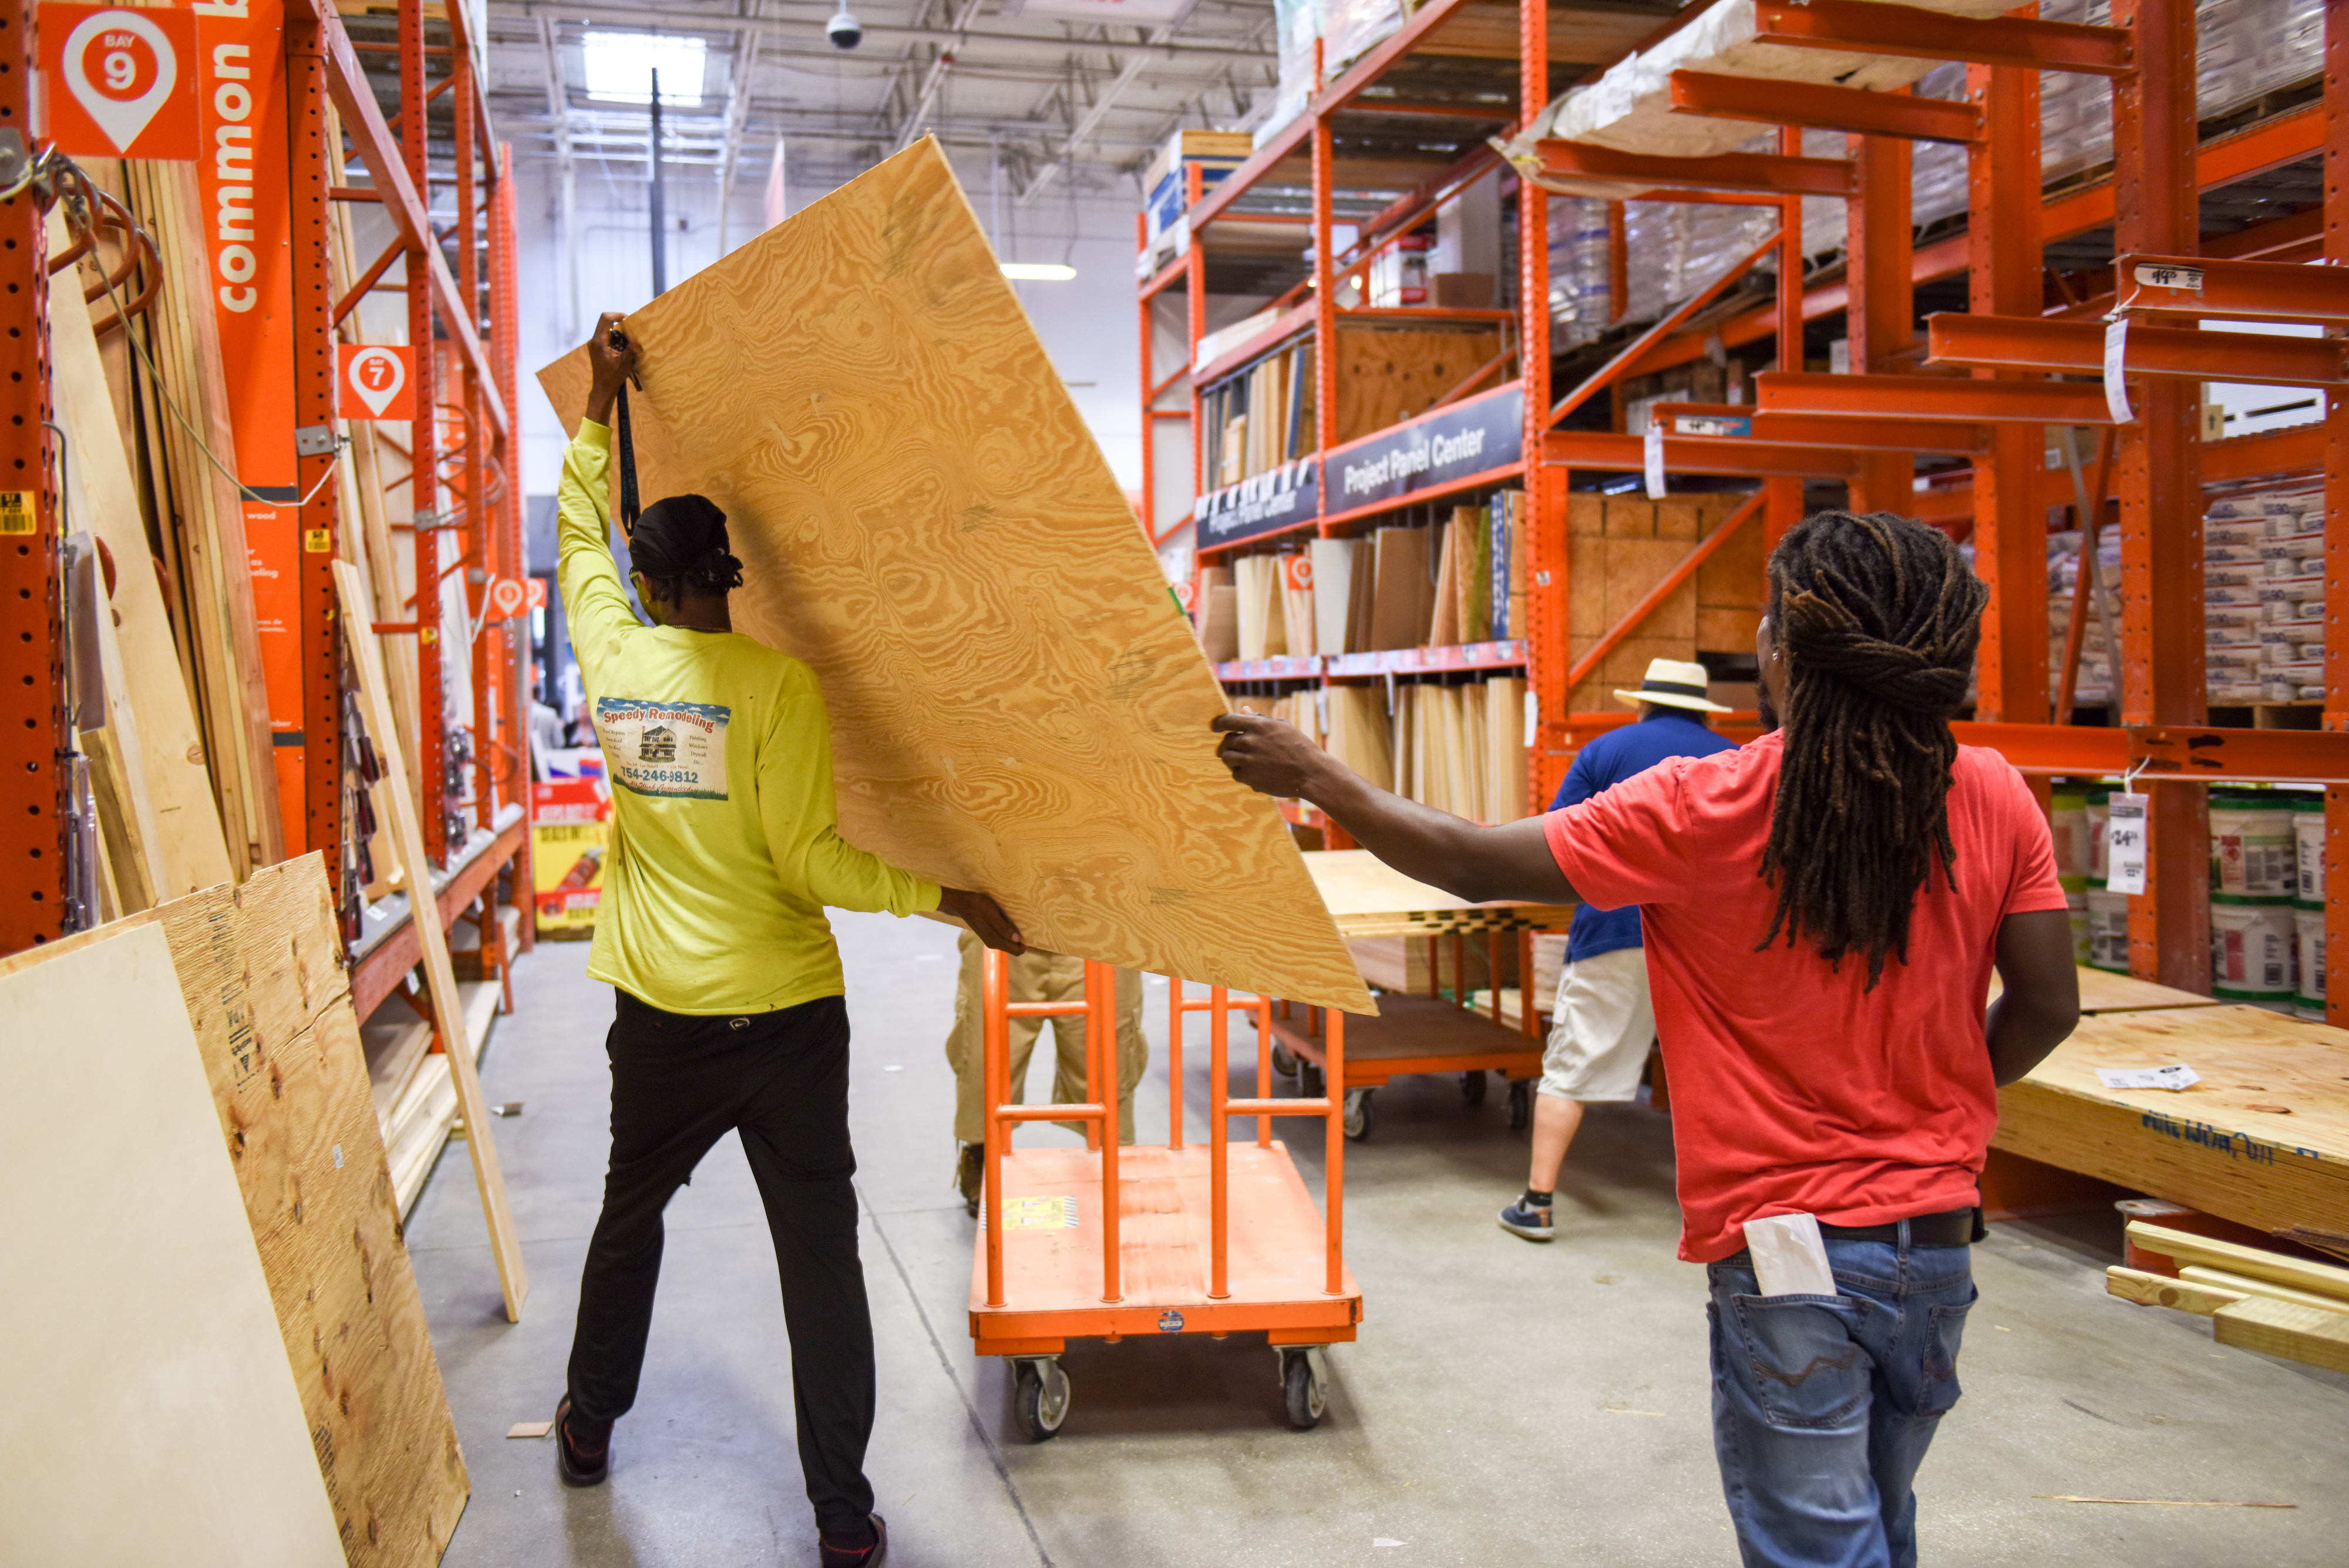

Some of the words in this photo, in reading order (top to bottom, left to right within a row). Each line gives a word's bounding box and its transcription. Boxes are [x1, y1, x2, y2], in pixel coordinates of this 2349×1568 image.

[105, 34, 134, 47] BAY
[104, 51, 136, 90] 9
[212, 43, 258, 313] common
[369, 366, 385, 386] 7
[1344, 455, 1389, 495] Project
[1390, 439, 1430, 481] Panel
[1432, 428, 1486, 467] Center
[247, 511, 276, 520] wood
[604, 706, 645, 724] Speedy
[649, 707, 715, 733] Remodeling
[621, 766, 699, 783] 754-246-9812
